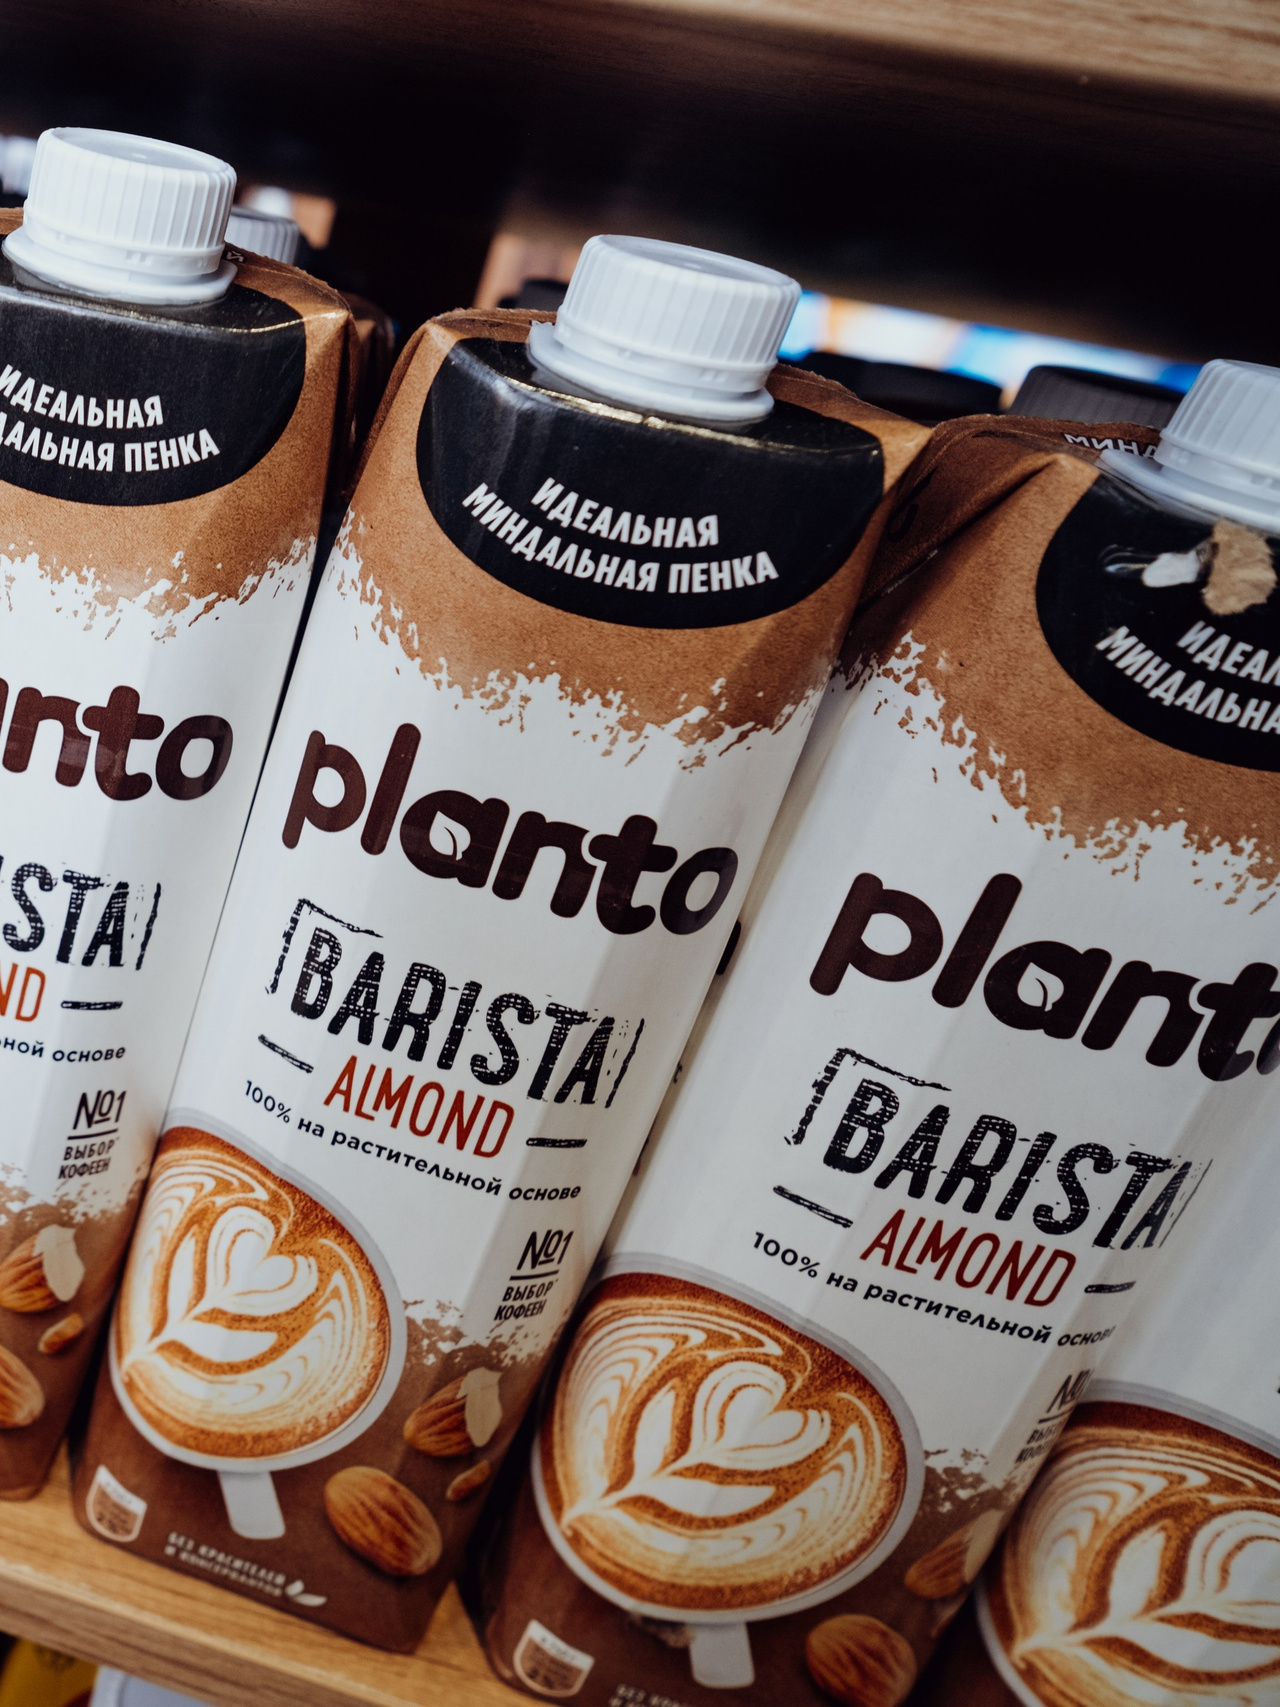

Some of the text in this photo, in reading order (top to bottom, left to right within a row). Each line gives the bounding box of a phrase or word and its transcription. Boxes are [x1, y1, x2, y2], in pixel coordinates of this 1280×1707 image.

[124, 427, 221, 473] ПЕНКА
[461, 482, 779, 593] МИНДАЛЬНАЯ ПЕНКА
[530, 477, 719, 549] ИДЕАЛЬНАЯ
[281, 722, 739, 936] planto
[51, 1045, 126, 1063] основе
[289, 926, 616, 1106] BARISTA
[244, 1079, 582, 1201] 100% на растительной основе
[323, 1054, 515, 1160] ALMOND
[57, 1157, 112, 1180] КОФЕЕН
[822, 1077, 1194, 1251] BARISTA
[493, 1299, 548, 1321] КОФЕЕН
[753, 1231, 821, 1278] 100%
[826, 1271, 858, 1294] на
[863, 1282, 1052, 1344] растительной
[860, 1208, 1077, 1308] ALMOND
